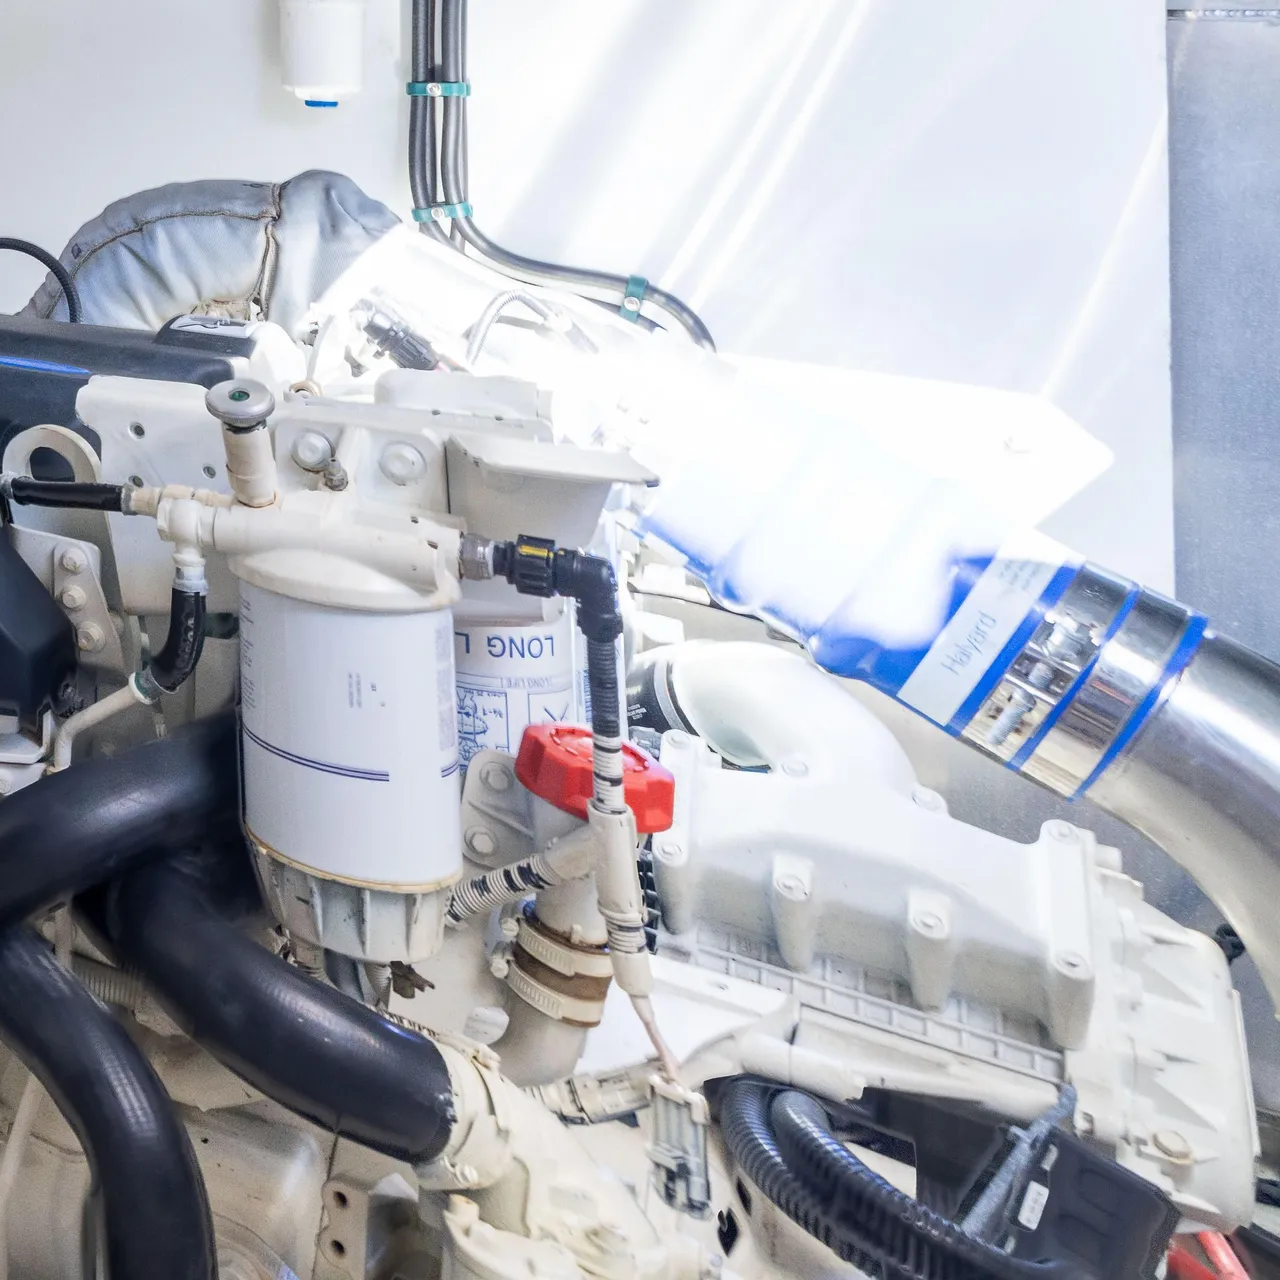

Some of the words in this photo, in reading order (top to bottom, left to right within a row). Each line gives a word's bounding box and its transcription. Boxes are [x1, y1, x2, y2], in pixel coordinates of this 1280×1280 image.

[487, 635, 554, 659] LONG
[941, 610, 996, 676] Halyard
[527, 676, 552, 688] LONG
